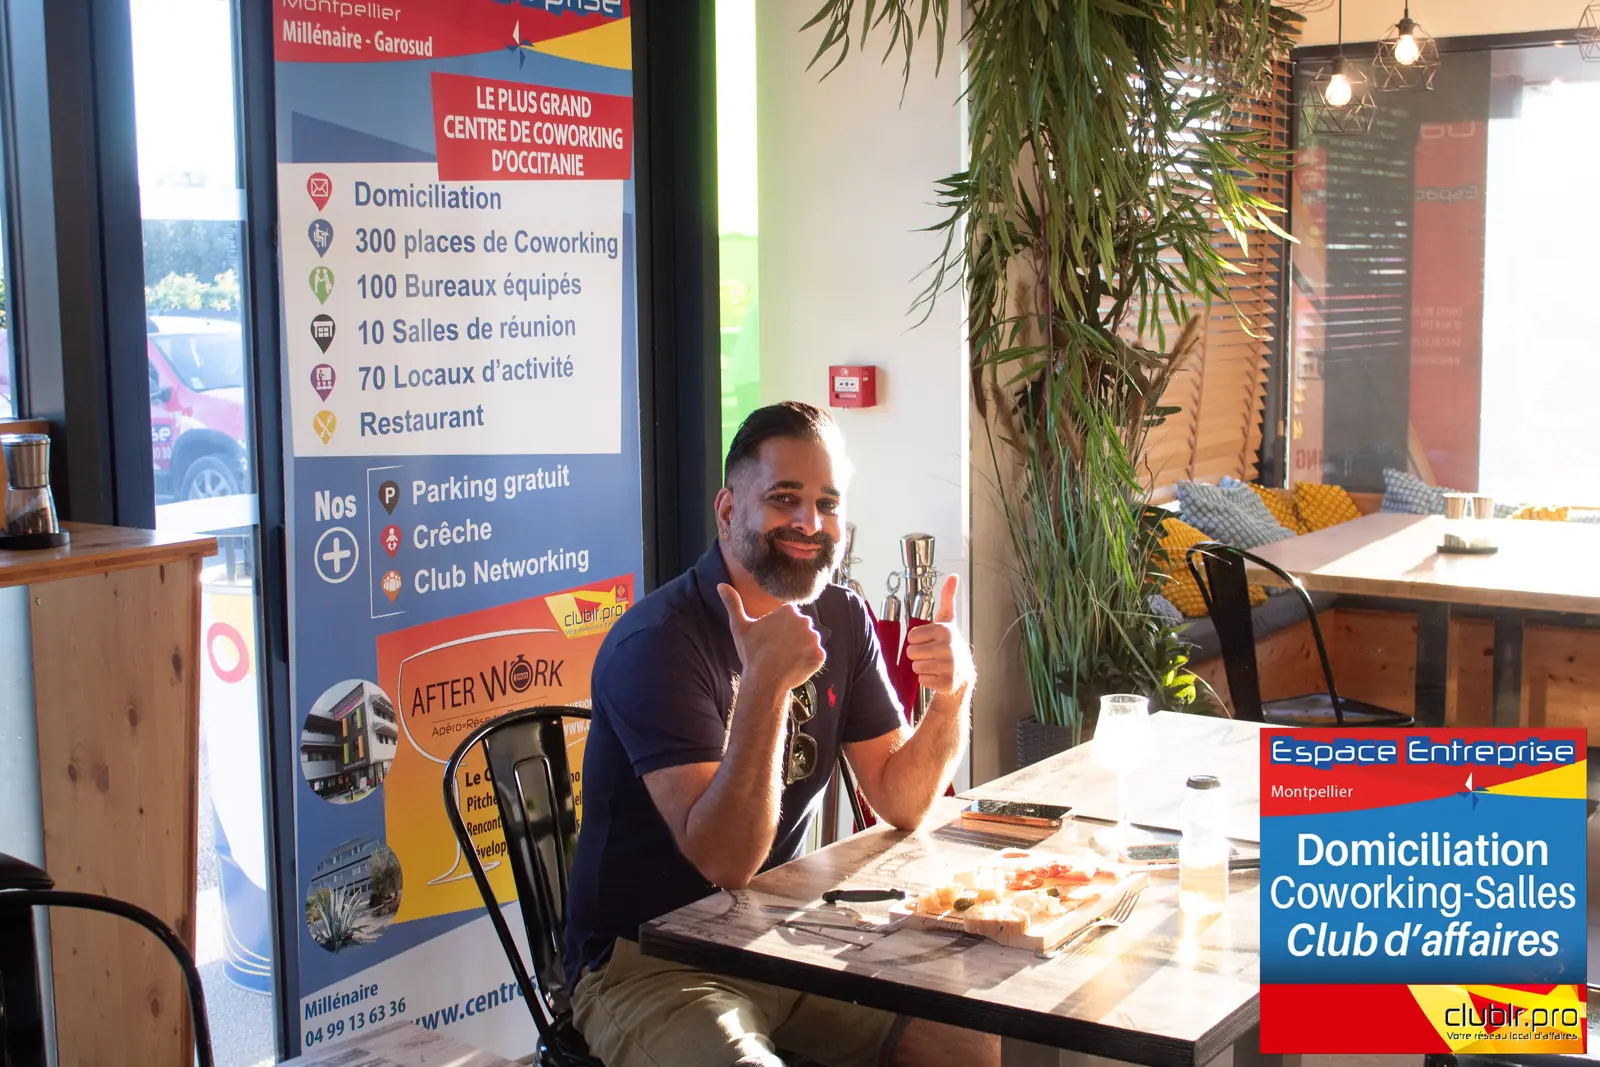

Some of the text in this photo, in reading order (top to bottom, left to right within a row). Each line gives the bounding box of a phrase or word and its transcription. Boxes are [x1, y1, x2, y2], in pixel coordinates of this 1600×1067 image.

[283, 20, 362, 49] Millénaire
[374, 30, 433, 57] Garosud
[476, 86, 592, 118] LE PLUS GRAND
[443, 115, 623, 150] CENTRE DE COWORKING
[354, 181, 502, 210] Domiciliation
[355, 227, 618, 259] 300 places de Coworking
[357, 272, 582, 301] 100 Bureaux équipés
[358, 314, 576, 345] 10 Salles de réunion
[358, 366, 386, 392] 70
[394, 361, 475, 389] Locaux
[360, 404, 485, 437] Restaurant
[385, 487, 396, 504] P
[412, 464, 570, 505] Parking gratuit
[314, 490, 357, 522] Nos
[413, 519, 492, 550] Crêche
[414, 548, 590, 594] Club Networking
[564, 604, 623, 627] clublr.pro
[412, 677, 476, 718] AFTER
[465, 772, 481, 788] Le
[305, 984, 378, 1020] Millénaire
[305, 996, 406, 1047] 04 99 13 63 36
